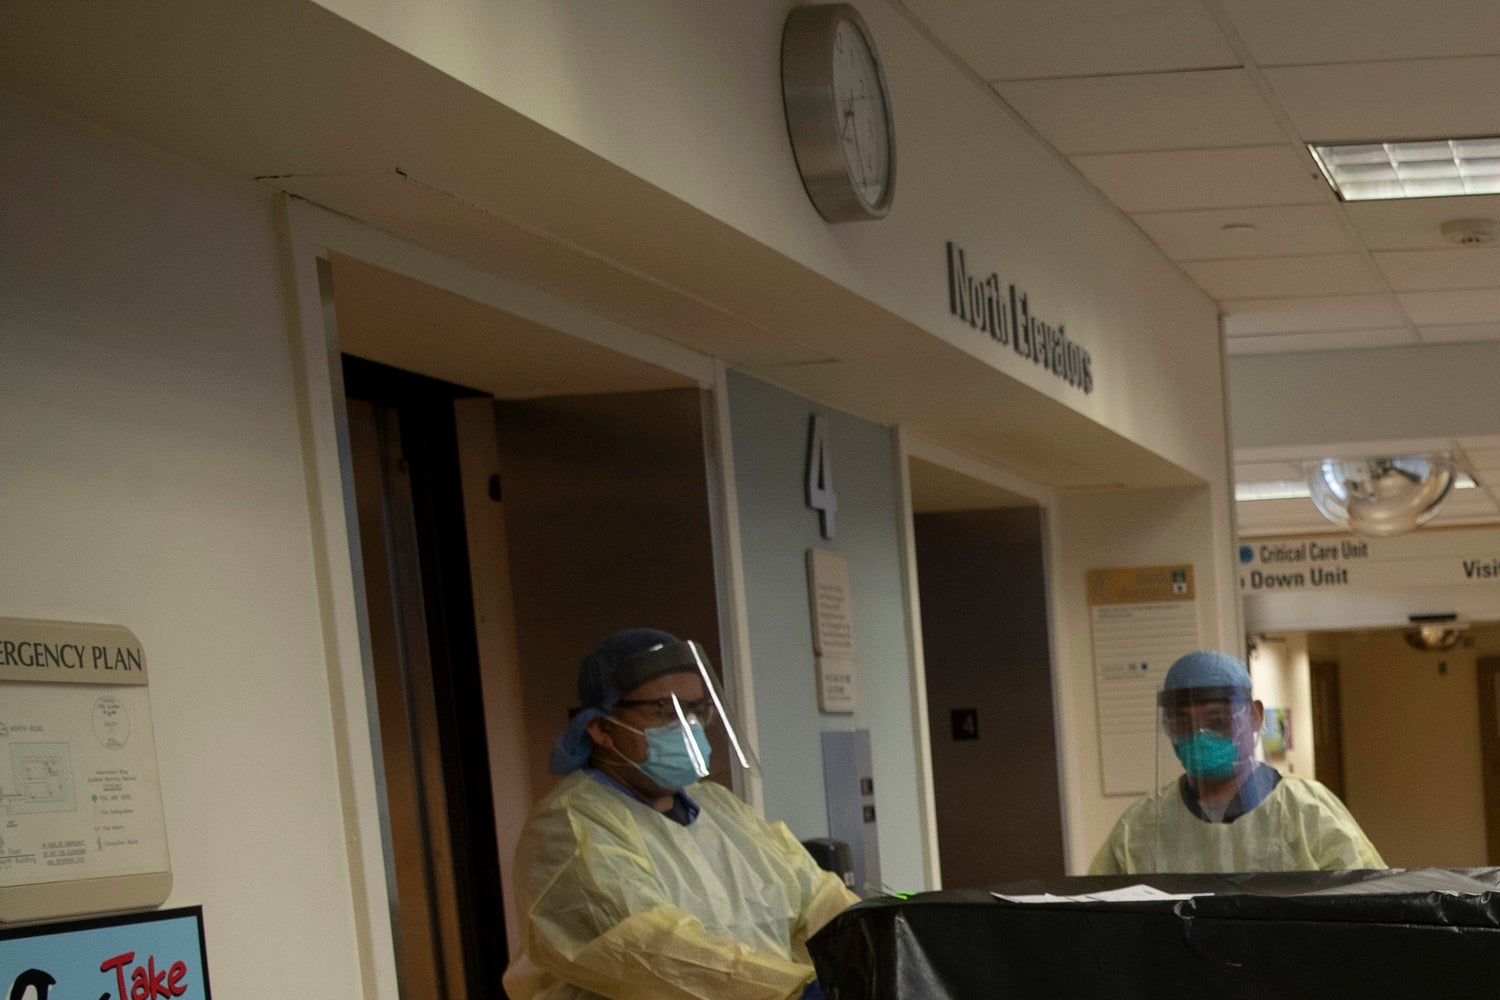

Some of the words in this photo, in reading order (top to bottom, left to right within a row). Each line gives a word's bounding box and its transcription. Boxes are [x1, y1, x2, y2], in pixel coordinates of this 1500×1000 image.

[946, 241, 1008, 346] North
[1009, 285, 1093, 395] Elevators
[804, 414, 837, 541] 4
[1259, 544, 1306, 564] Critical
[1309, 543, 1338, 561] Care
[1342, 541, 1368, 560] Unit
[1251, 569, 1304, 589] Down
[1310, 566, 1348, 586] Unit
[92, 646, 142, 672] PLAN
